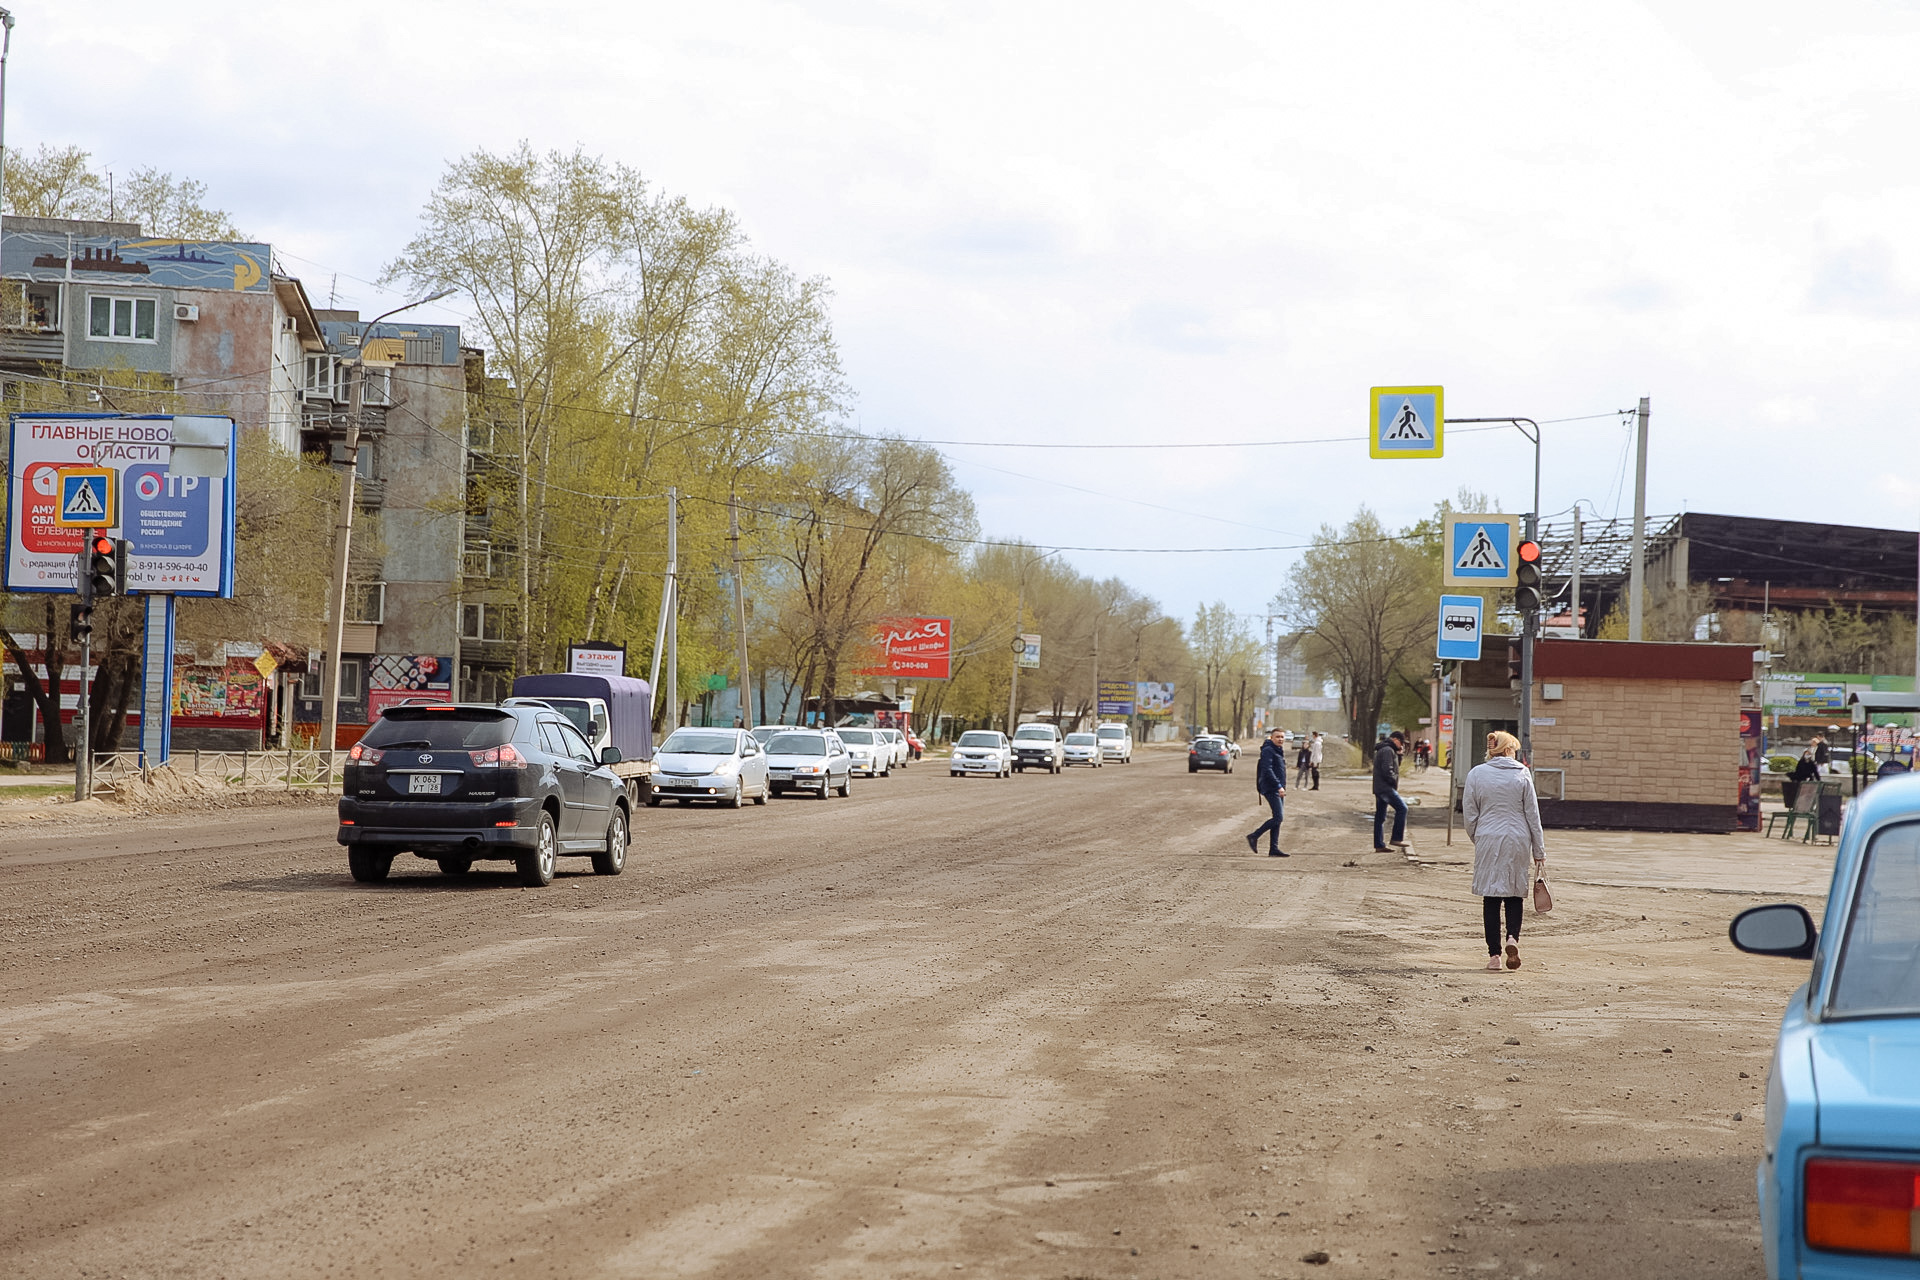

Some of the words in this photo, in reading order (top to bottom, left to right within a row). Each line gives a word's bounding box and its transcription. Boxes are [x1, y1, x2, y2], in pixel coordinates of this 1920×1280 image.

[31, 425, 114, 440] ГЛАВНЫЕ
[31, 505, 56, 514] АМУ
[140, 510, 187, 518] ОБЩЕСТВЕННОЕ
[31, 516, 56, 525] ОБЛ
[140, 519, 183, 528] ТЕЛЕВИДЕНИЕ
[31, 526, 99, 537] ТЕЛЕВИДЕНЕ
[140, 528, 165, 536] РОССИИ
[28, 560, 66, 568] редакция
[138, 561, 208, 571] 8-914-596-40-40
[422, 775, 437, 783] 063
[413, 784, 425, 792] УТ
